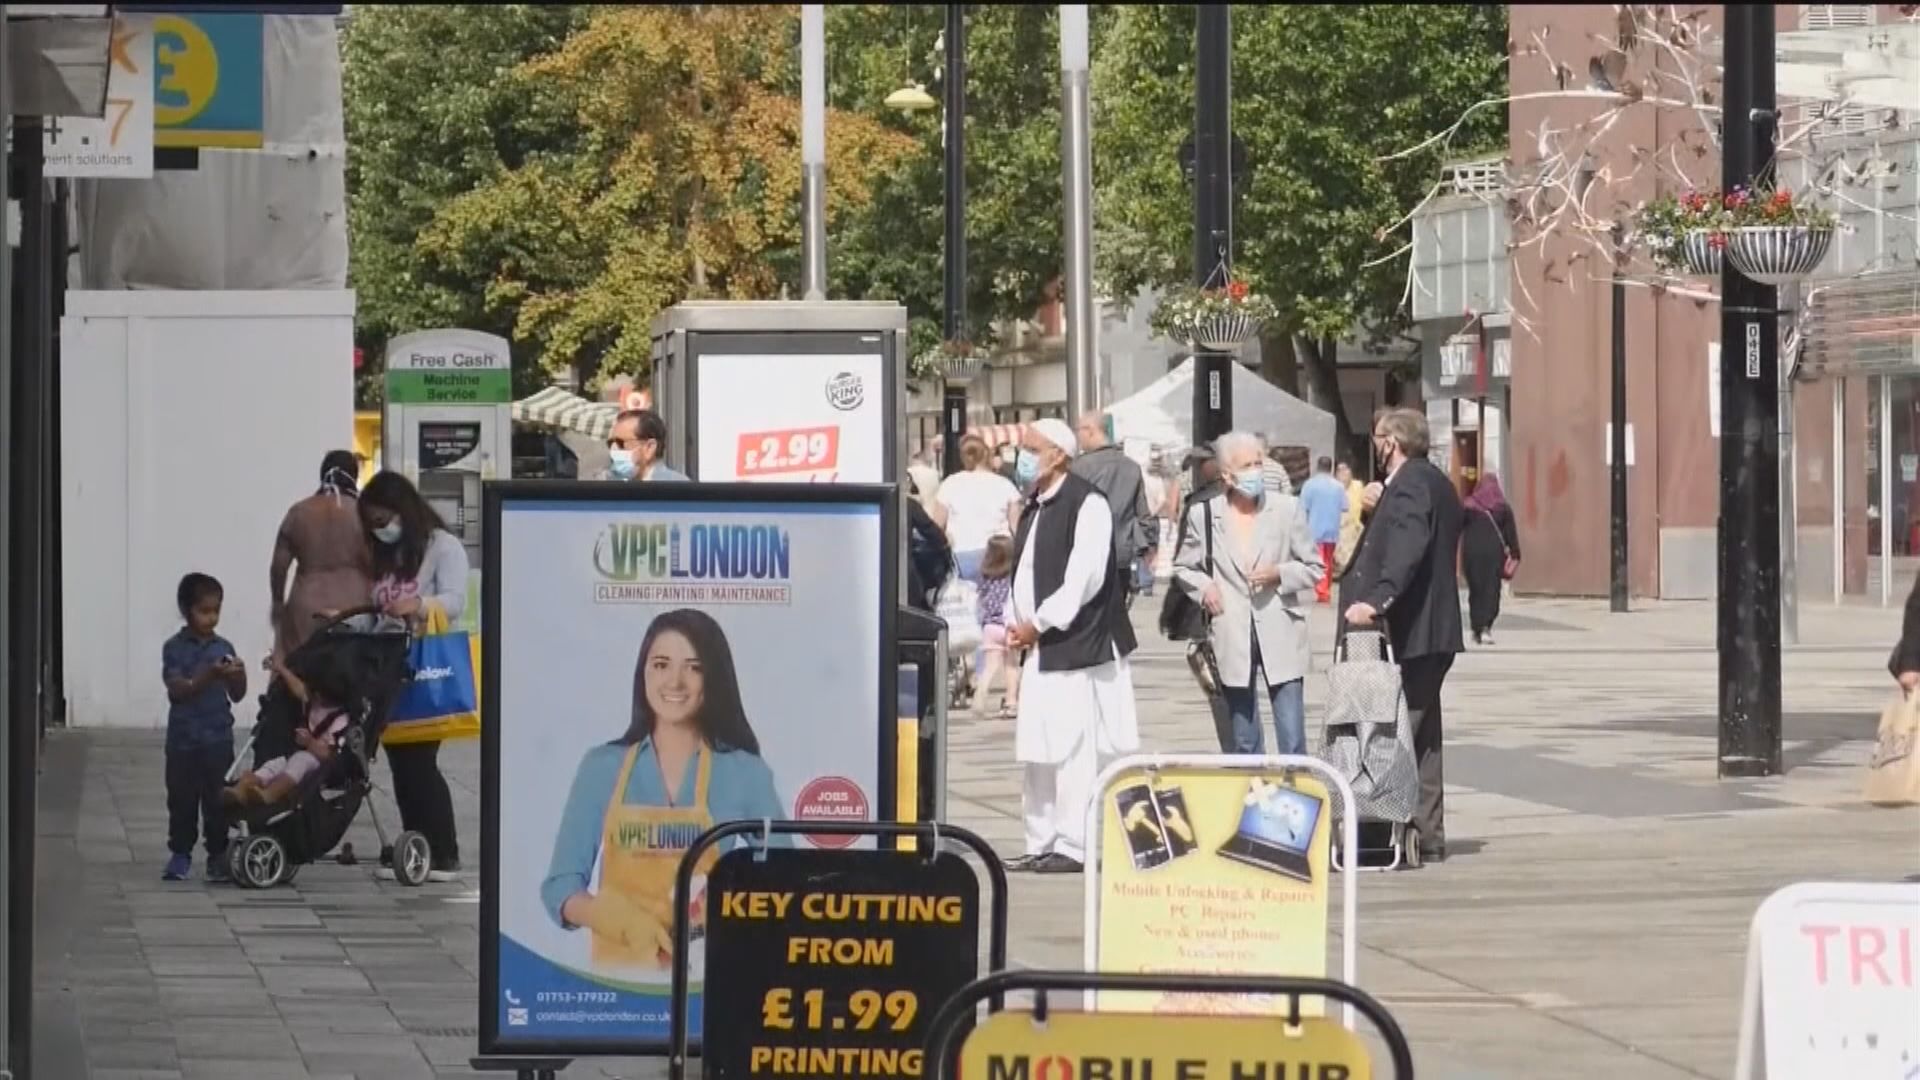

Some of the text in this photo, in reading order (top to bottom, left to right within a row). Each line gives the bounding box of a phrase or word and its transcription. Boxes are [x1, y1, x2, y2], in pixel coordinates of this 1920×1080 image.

[76, 154, 134, 166] solutions
[410, 353, 494, 367] Free Cash
[423, 374, 481, 386] Machine
[427, 388, 478, 400] Service
[830, 384, 864, 402] KING
[743, 432, 829, 470] £2.99
[597, 587, 786, 601] CLEANING PAINTING MAINTENANCE
[816, 791, 849, 802] JOBS
[802, 805, 864, 815] AVAILABLE
[1111, 882, 1161, 897] Mobile
[1166, 883, 1239, 901] Unlocking
[1261, 887, 1315, 904] Repairs
[721, 892, 962, 922] KEY CUTTING
[1170, 904, 1257, 922] PC Repairs
[1195, 927, 1227, 940] used
[787, 937, 894, 965] FROM
[762, 987, 918, 1030] £1.99
[750, 1046, 924, 1075] PRINTING
